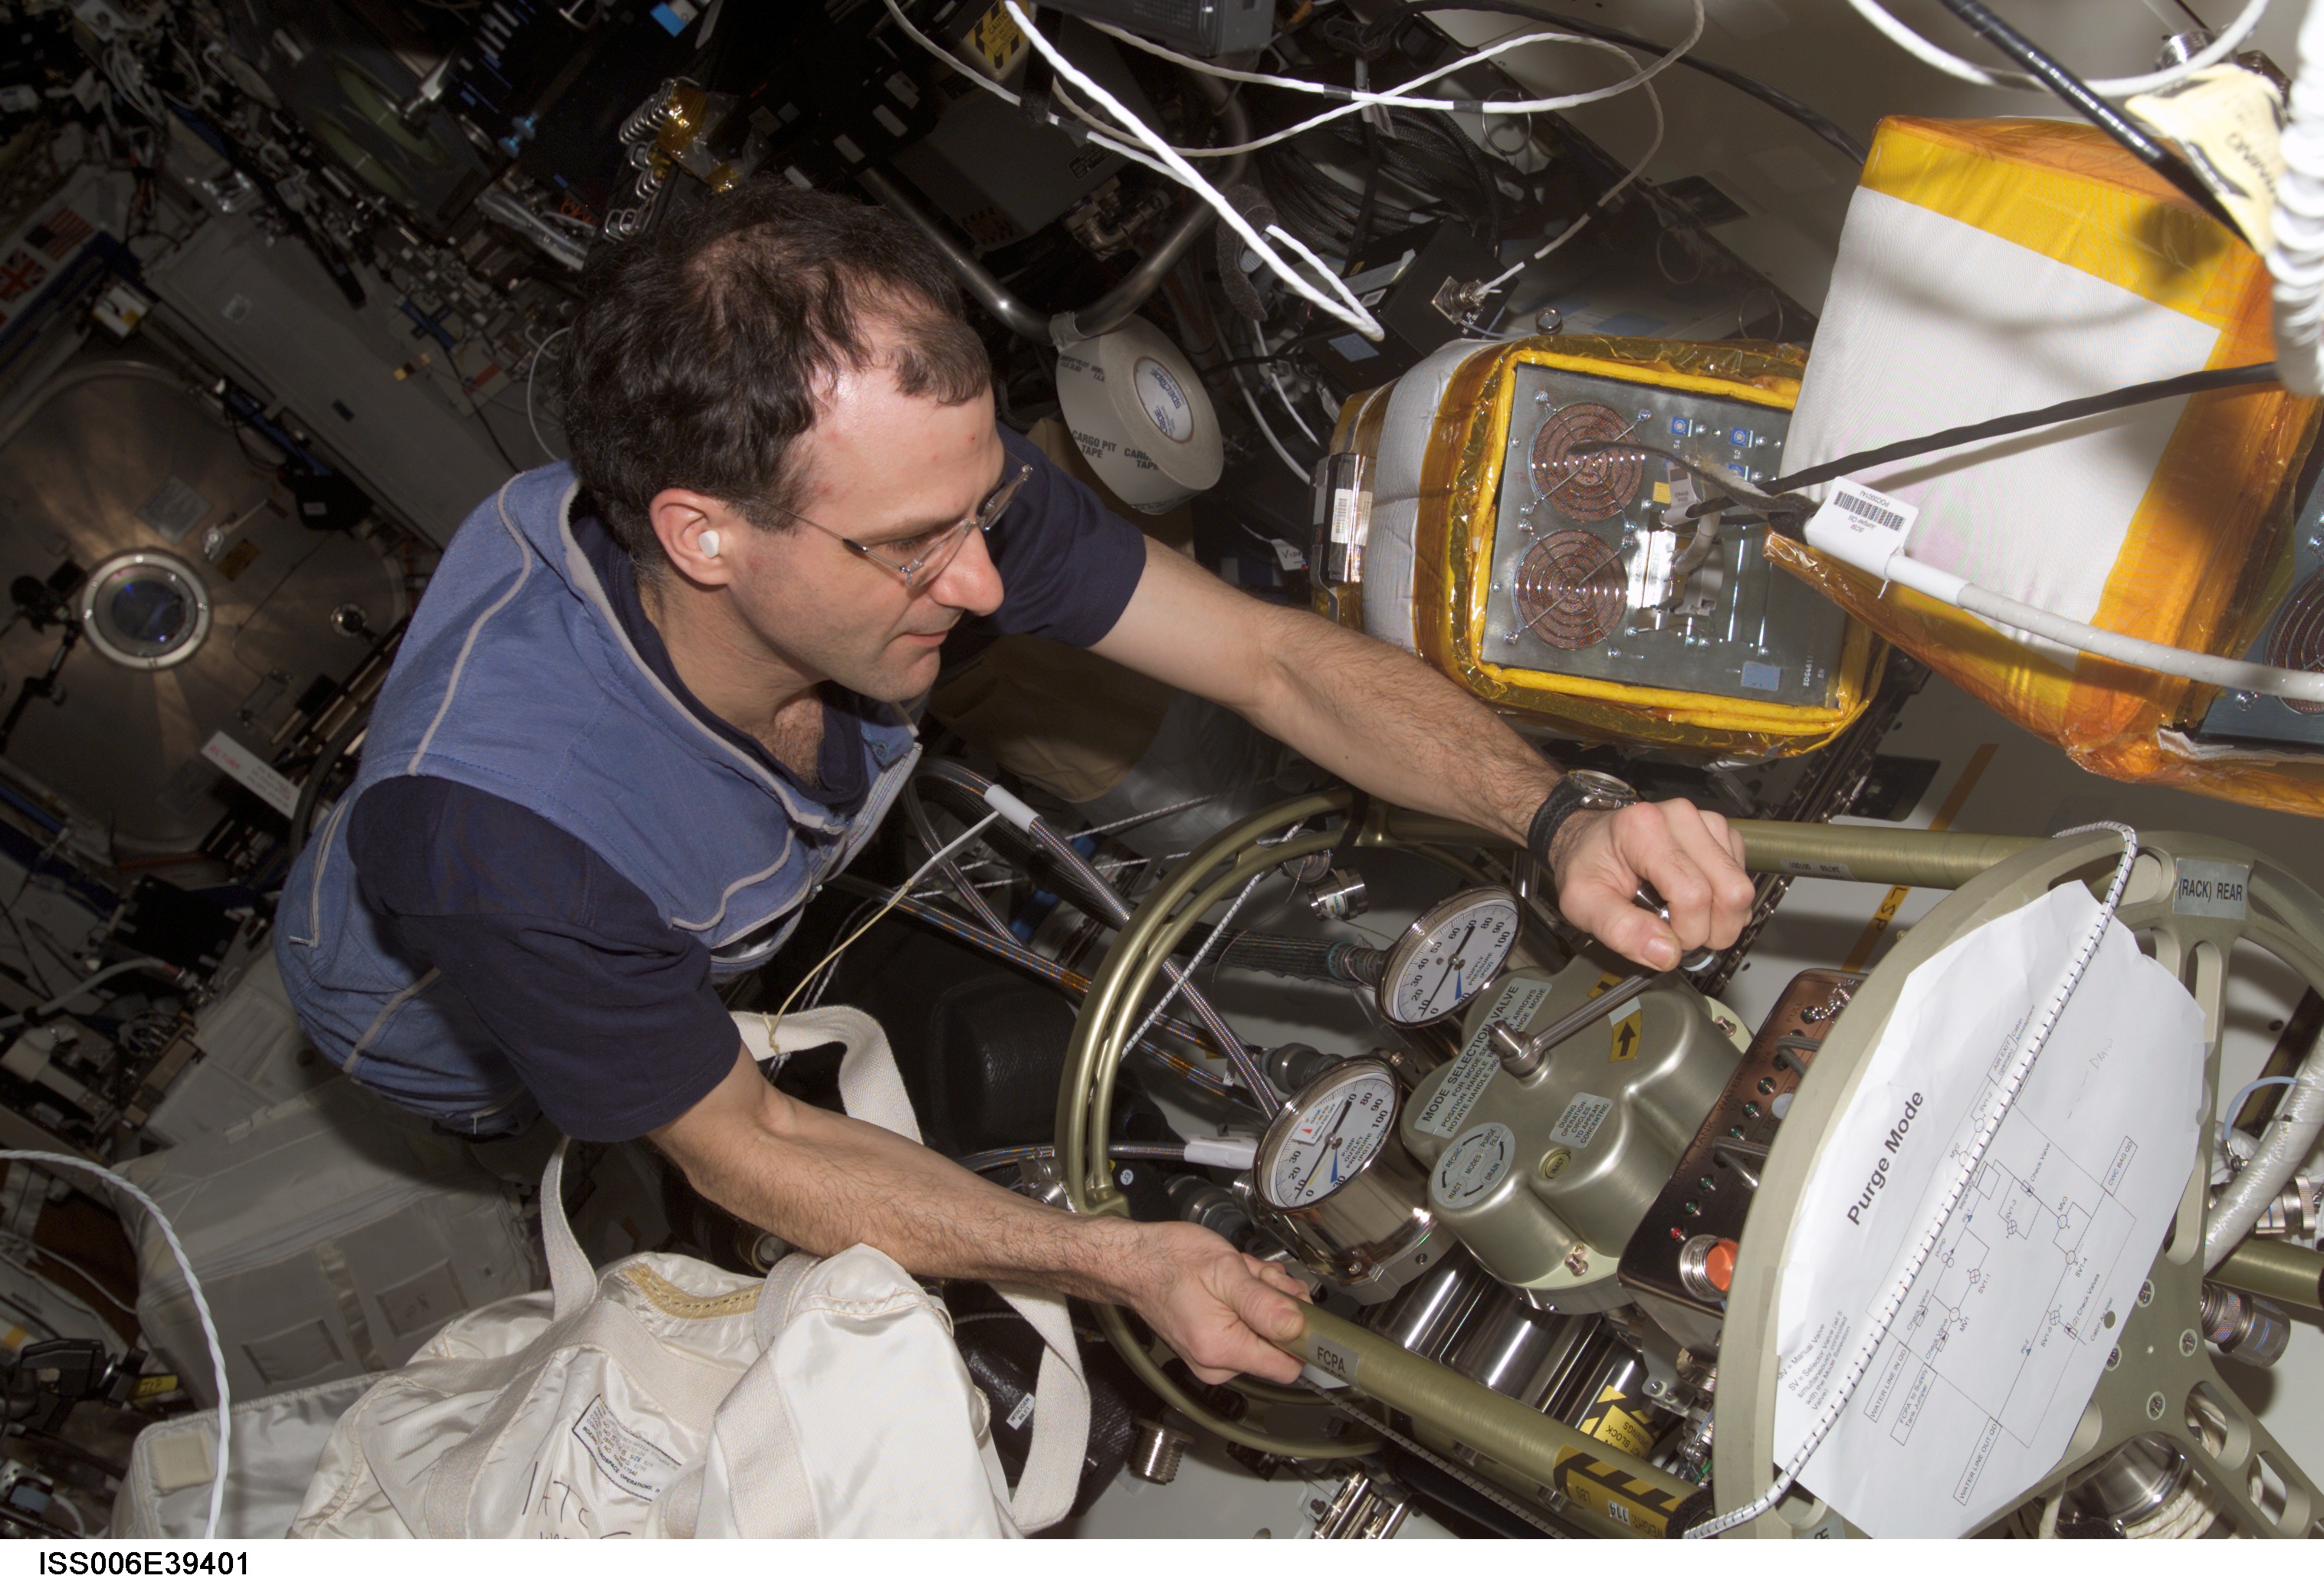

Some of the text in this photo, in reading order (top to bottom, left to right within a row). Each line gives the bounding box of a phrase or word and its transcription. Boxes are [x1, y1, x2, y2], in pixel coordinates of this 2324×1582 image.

[1072, 430, 1117, 452] CARGO PIT
[1082, 443, 1104, 459] TAPE
[2178, 878, 2243, 903] (RACK) REAR
[1448, 927, 1461, 940] 60
[1480, 917, 1493, 930] 80
[1492, 921, 1505, 934] 90
[1430, 941, 1443, 954] 50
[1494, 931, 1511, 949] 100
[1417, 958, 1430, 970] 40
[1466, 957, 1484, 980] SUPPLY
[1468, 952, 1493, 986] PRESSURE
[1410, 975, 1423, 986] 30
[1411, 989, 1423, 1002] 20
[1418, 999, 1431, 1012] 10
[1785, 1002, 1803, 1023] FULL
[2016, 1004, 2036, 1042] Atmosphere
[2011, 1017, 2024, 1037] Cabin
[1423, 1088, 1450, 1122] MODE
[1447, 1024, 1492, 1085] SELECTION
[1490, 986, 1519, 1019] VALVE
[1441, 989, 1537, 1127] POSITION HANDLE ARROWS
[1446, 1103, 1469, 1133] ROTATE
[1468, 1073, 1490, 1103] HANDLE
[1531, 988, 1547, 1009] MODE
[1993, 1041, 2011, 1071] AIR EXIT
[1452, 1057, 1482, 1098] FOR MODE
[1360, 1092, 1373, 1105] 80
[1370, 1098, 1384, 1111] 90
[1979, 1091, 1993, 1113] SV1-2
[1371, 1110, 1388, 1128] 100
[1559, 1104, 1577, 1128] DURING
[1561, 1100, 1588, 1137] OPERATION:
[1571, 1106, 1591, 1134] CIRCLES
[1574, 1104, 1601, 1140] TO APPEAR
[1580, 1103, 1609, 1144] CONCENTRIC
[1660, 1029, 1774, 1203] SUPPLY TANK WATER LEVEL
[1341, 1137, 1356, 1157] PUMP
[1480, 1127, 1498, 1147] PURGE
[1489, 1135, 1501, 1147] FILL
[1288, 1150, 1302, 1164] 30
[1344, 1136, 1363, 1162] OUTLET
[1346, 1133, 1373, 1169] PRESSURE
[1445, 1147, 1463, 1168] RECIRC
[1846, 1092, 1924, 1226] Purge Mode
[1949, 1142, 1961, 1160] MV2
[1288, 1167, 1301, 1180] 20
[1464, 1154, 1482, 1175] MODES
[1485, 1163, 1501, 1181] DRAIN
[1551, 1157, 1564, 1174] INACT
[2030, 1142, 2051, 1183] Check Valve
[2108, 1141, 2133, 1186] CWC BAG QD
[1294, 1179, 1308, 1192] 10
[1447, 1182, 1462, 1200] INACT
[1958, 1180, 1977, 1211] separator
[2004, 1199, 2017, 1220] SV1-3
[2057, 1196, 2069, 1212] MV3
[1935, 1238, 1946, 1258] pump
[2075, 1256, 2088, 1278] SV1-4
[1978, 1273, 1991, 1294] SV1-1
[1907, 1289, 1930, 1331] Check Valve
[2072, 1273, 2100, 1327] (2) Check Valves
[1959, 1317, 1970, 1332] MV1
[2090, 1322, 2101, 1341] Cabin
[1925, 1318, 1948, 1360] Check Valve
[1317, 1345, 1346, 1374] FCPA
[1777, 1368, 1788, 1381] MV
[1791, 1343, 1814, 1365] Manual
[1811, 1324, 1825, 1344] Valve
[1787, 1379, 1800, 1391] SV
[1802, 1350, 1824, 1377] Selector
[1822, 1329, 1834, 1349] Valve
[1797, 1315, 1847, 1399] simultaneously controlled
[1805, 1391, 1818, 1405] with
[1823, 1359, 1836, 1380] Mode
[1833, 1326, 1851, 1358] Selection
[1869, 1348, 1907, 1418] WATER LINE IN QD
[1811, 1389, 1830, 1410] Valve)
[1899, 1403, 1912, 1424] FCPA
[1914, 1367, 1929, 1391] Supply
[1905, 1383, 1928, 1429] Tank Jumper
[1010, 1397, 1030, 1422] NITROGEN
[1605, 1424, 1631, 1448] BLOCK
[1959, 1423, 1997, 1499] WATER LINE OUT QD
[1576, 1485, 1592, 1504] LBS
[1610, 1502, 1630, 1522] 114
